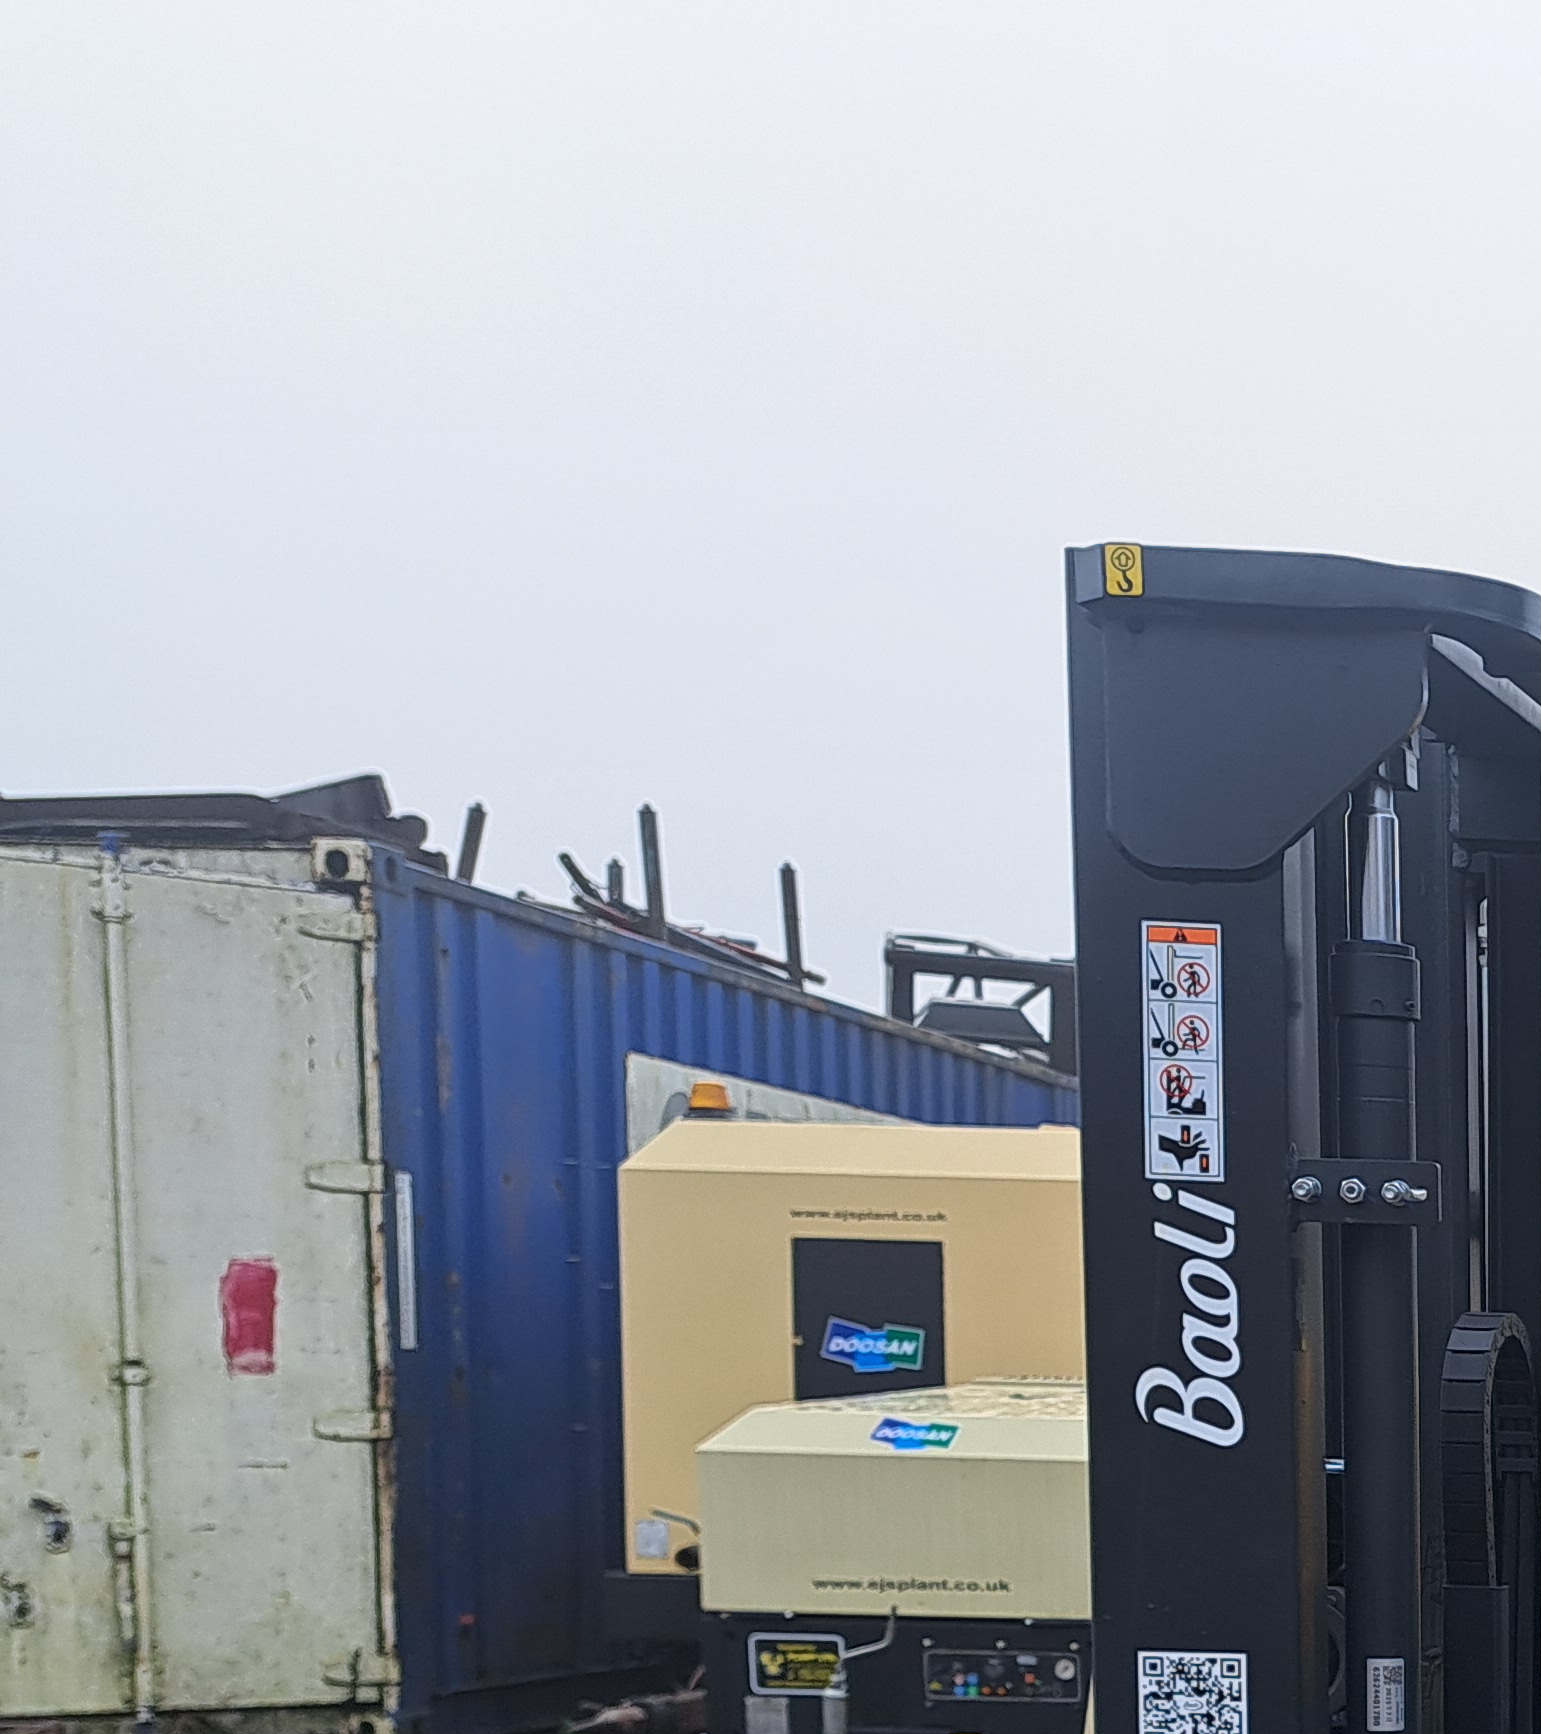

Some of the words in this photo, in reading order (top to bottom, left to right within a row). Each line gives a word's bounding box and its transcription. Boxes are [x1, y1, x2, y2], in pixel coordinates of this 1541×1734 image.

[1135, 1182, 1244, 1447] Baoli
[828, 1335, 920, 1356] DOOSAN
[875, 1426, 953, 1442] DOOSAN
[811, 1577, 1011, 1594] www.ejsplant.co.uk
